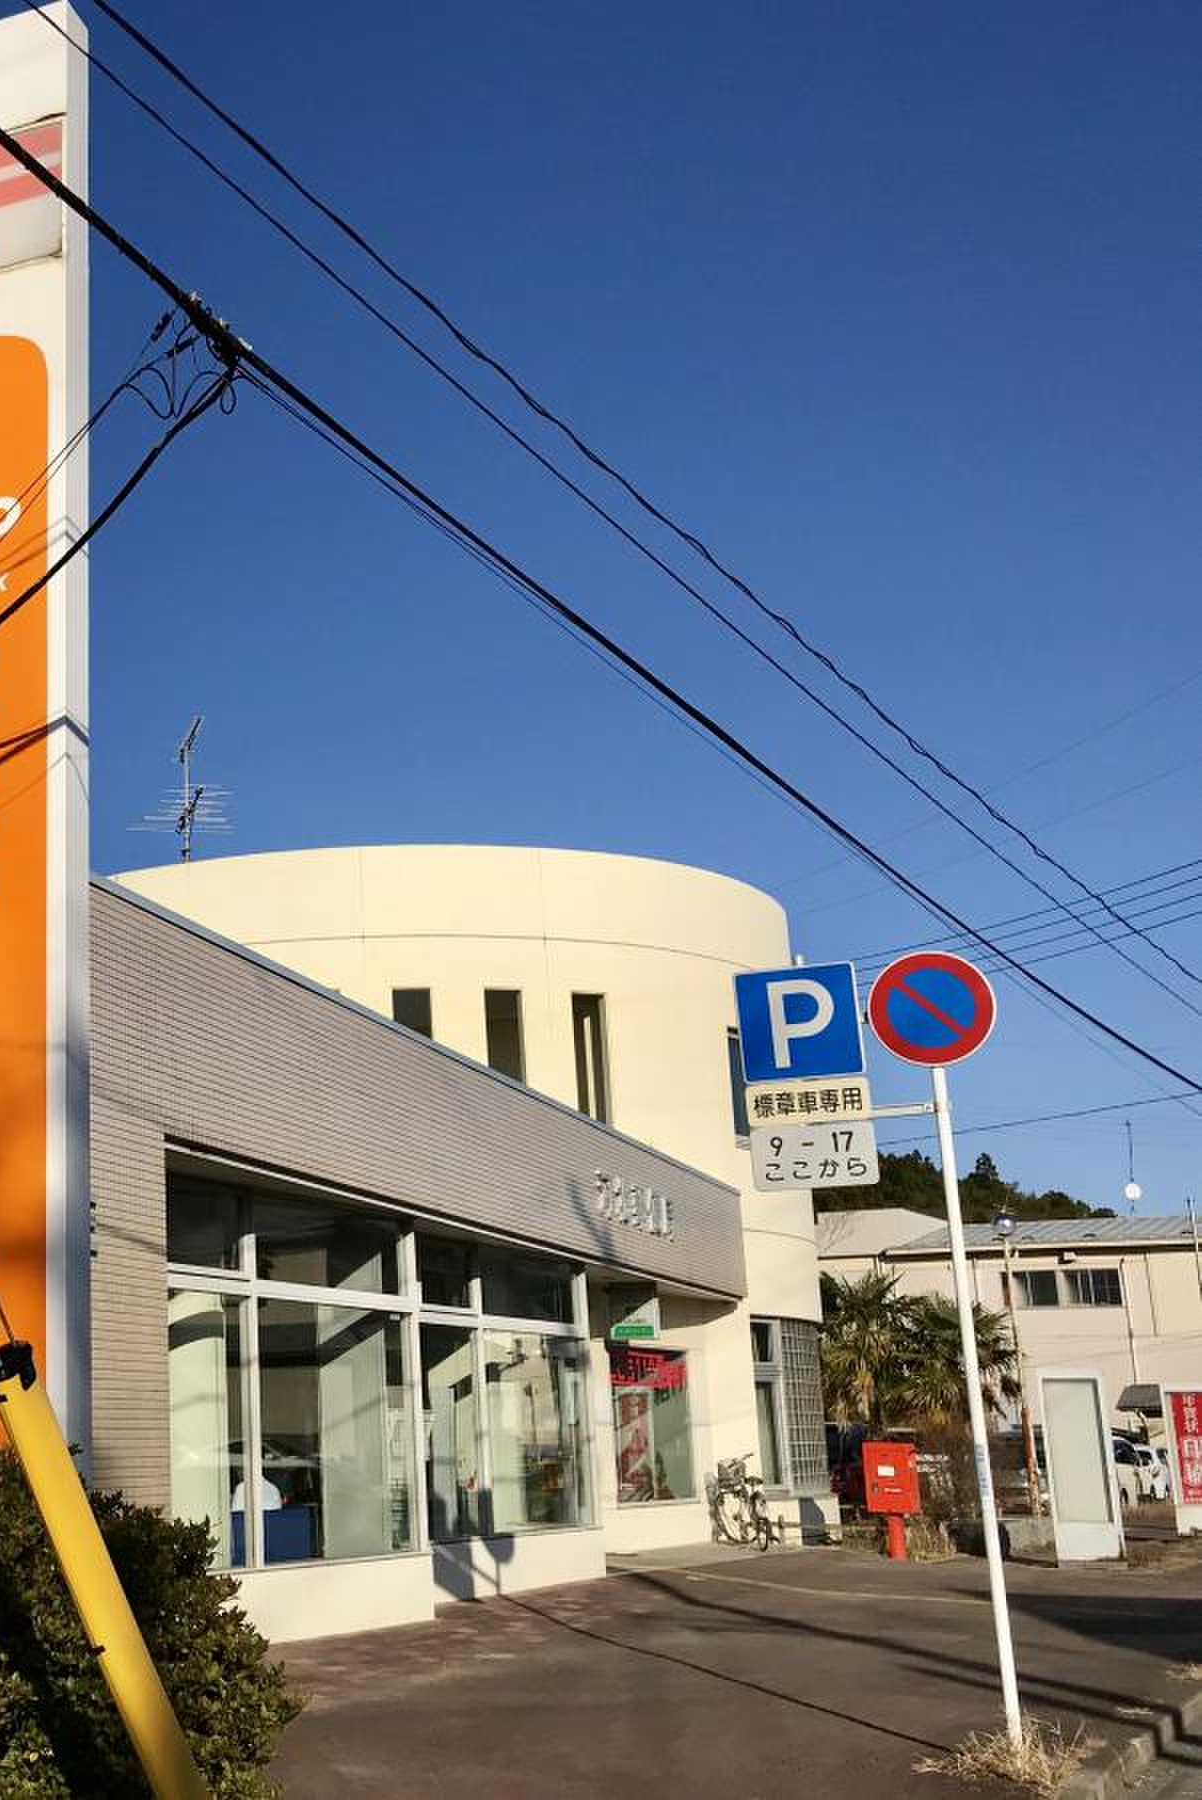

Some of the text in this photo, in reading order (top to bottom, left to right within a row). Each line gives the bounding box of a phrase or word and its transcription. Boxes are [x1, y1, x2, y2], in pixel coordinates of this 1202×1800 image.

[765, 978, 835, 1070] P
[754, 1087, 863, 1118] 標章車専用
[765, 1156, 868, 1181] ここから
